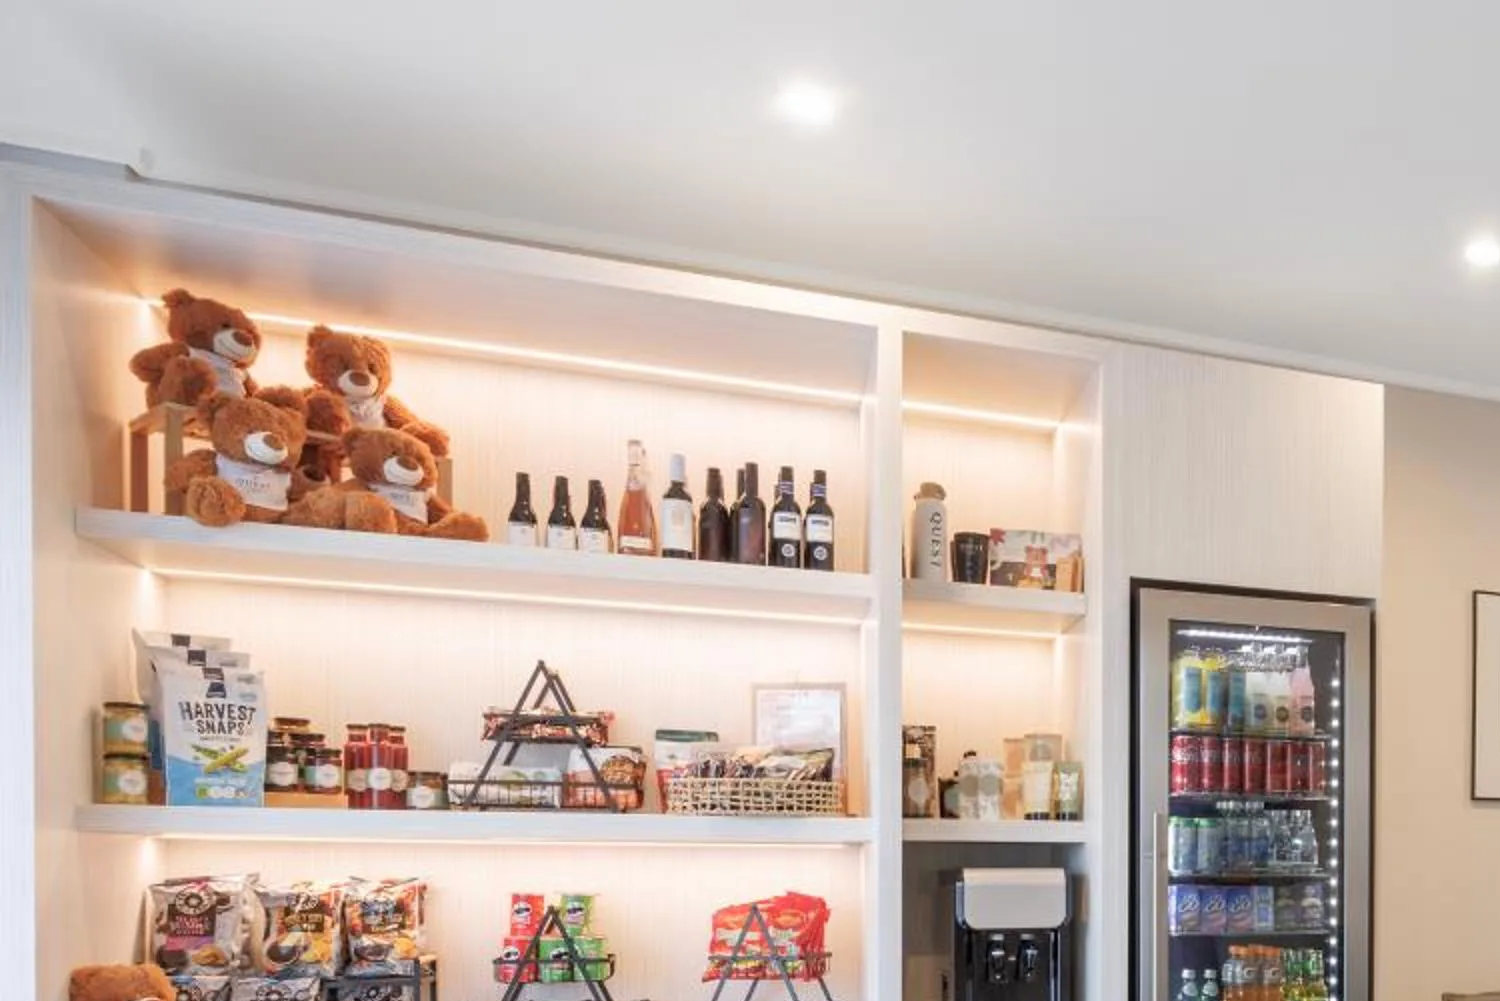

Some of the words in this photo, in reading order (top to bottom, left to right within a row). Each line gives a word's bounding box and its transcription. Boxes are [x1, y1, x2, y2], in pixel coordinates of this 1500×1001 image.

[930, 511, 942, 567] QUEST
[178, 701, 257, 725] HARVEST
[195, 719, 245, 736] SNAPS
